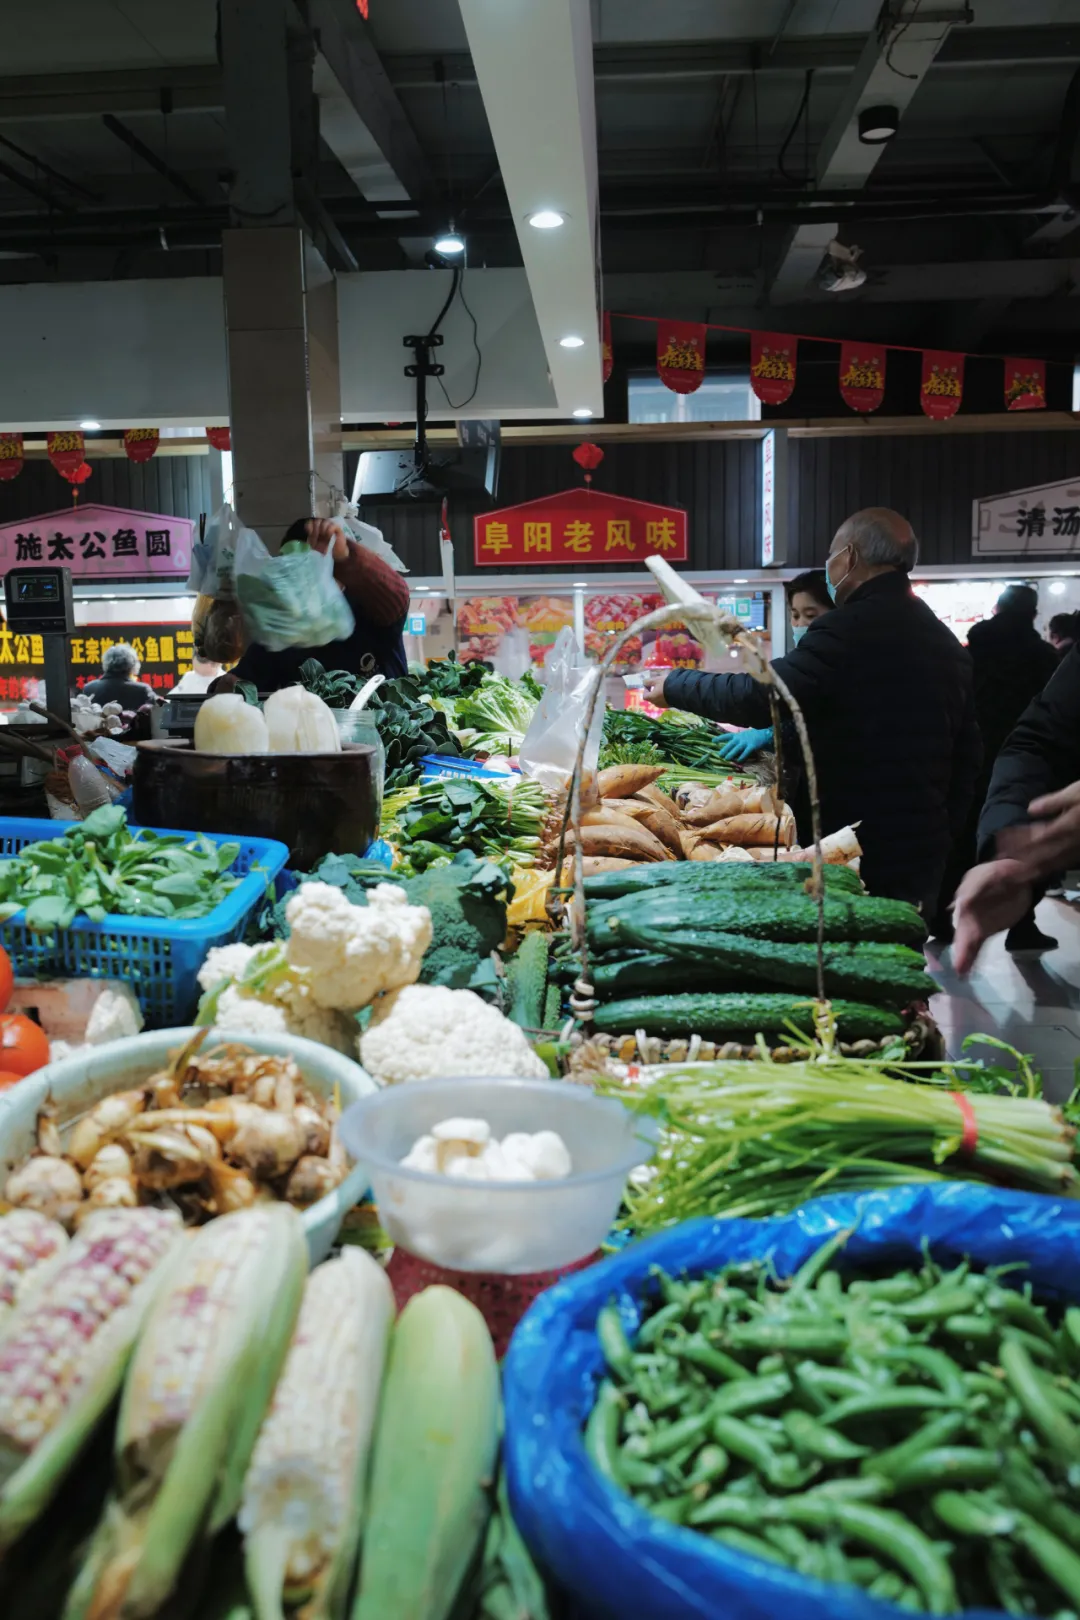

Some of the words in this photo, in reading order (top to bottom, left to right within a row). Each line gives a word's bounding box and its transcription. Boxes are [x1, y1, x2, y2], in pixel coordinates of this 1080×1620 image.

[14, 528, 171, 561] 施太公鱼圆
[481, 517, 677, 555] 阜阳老风味
